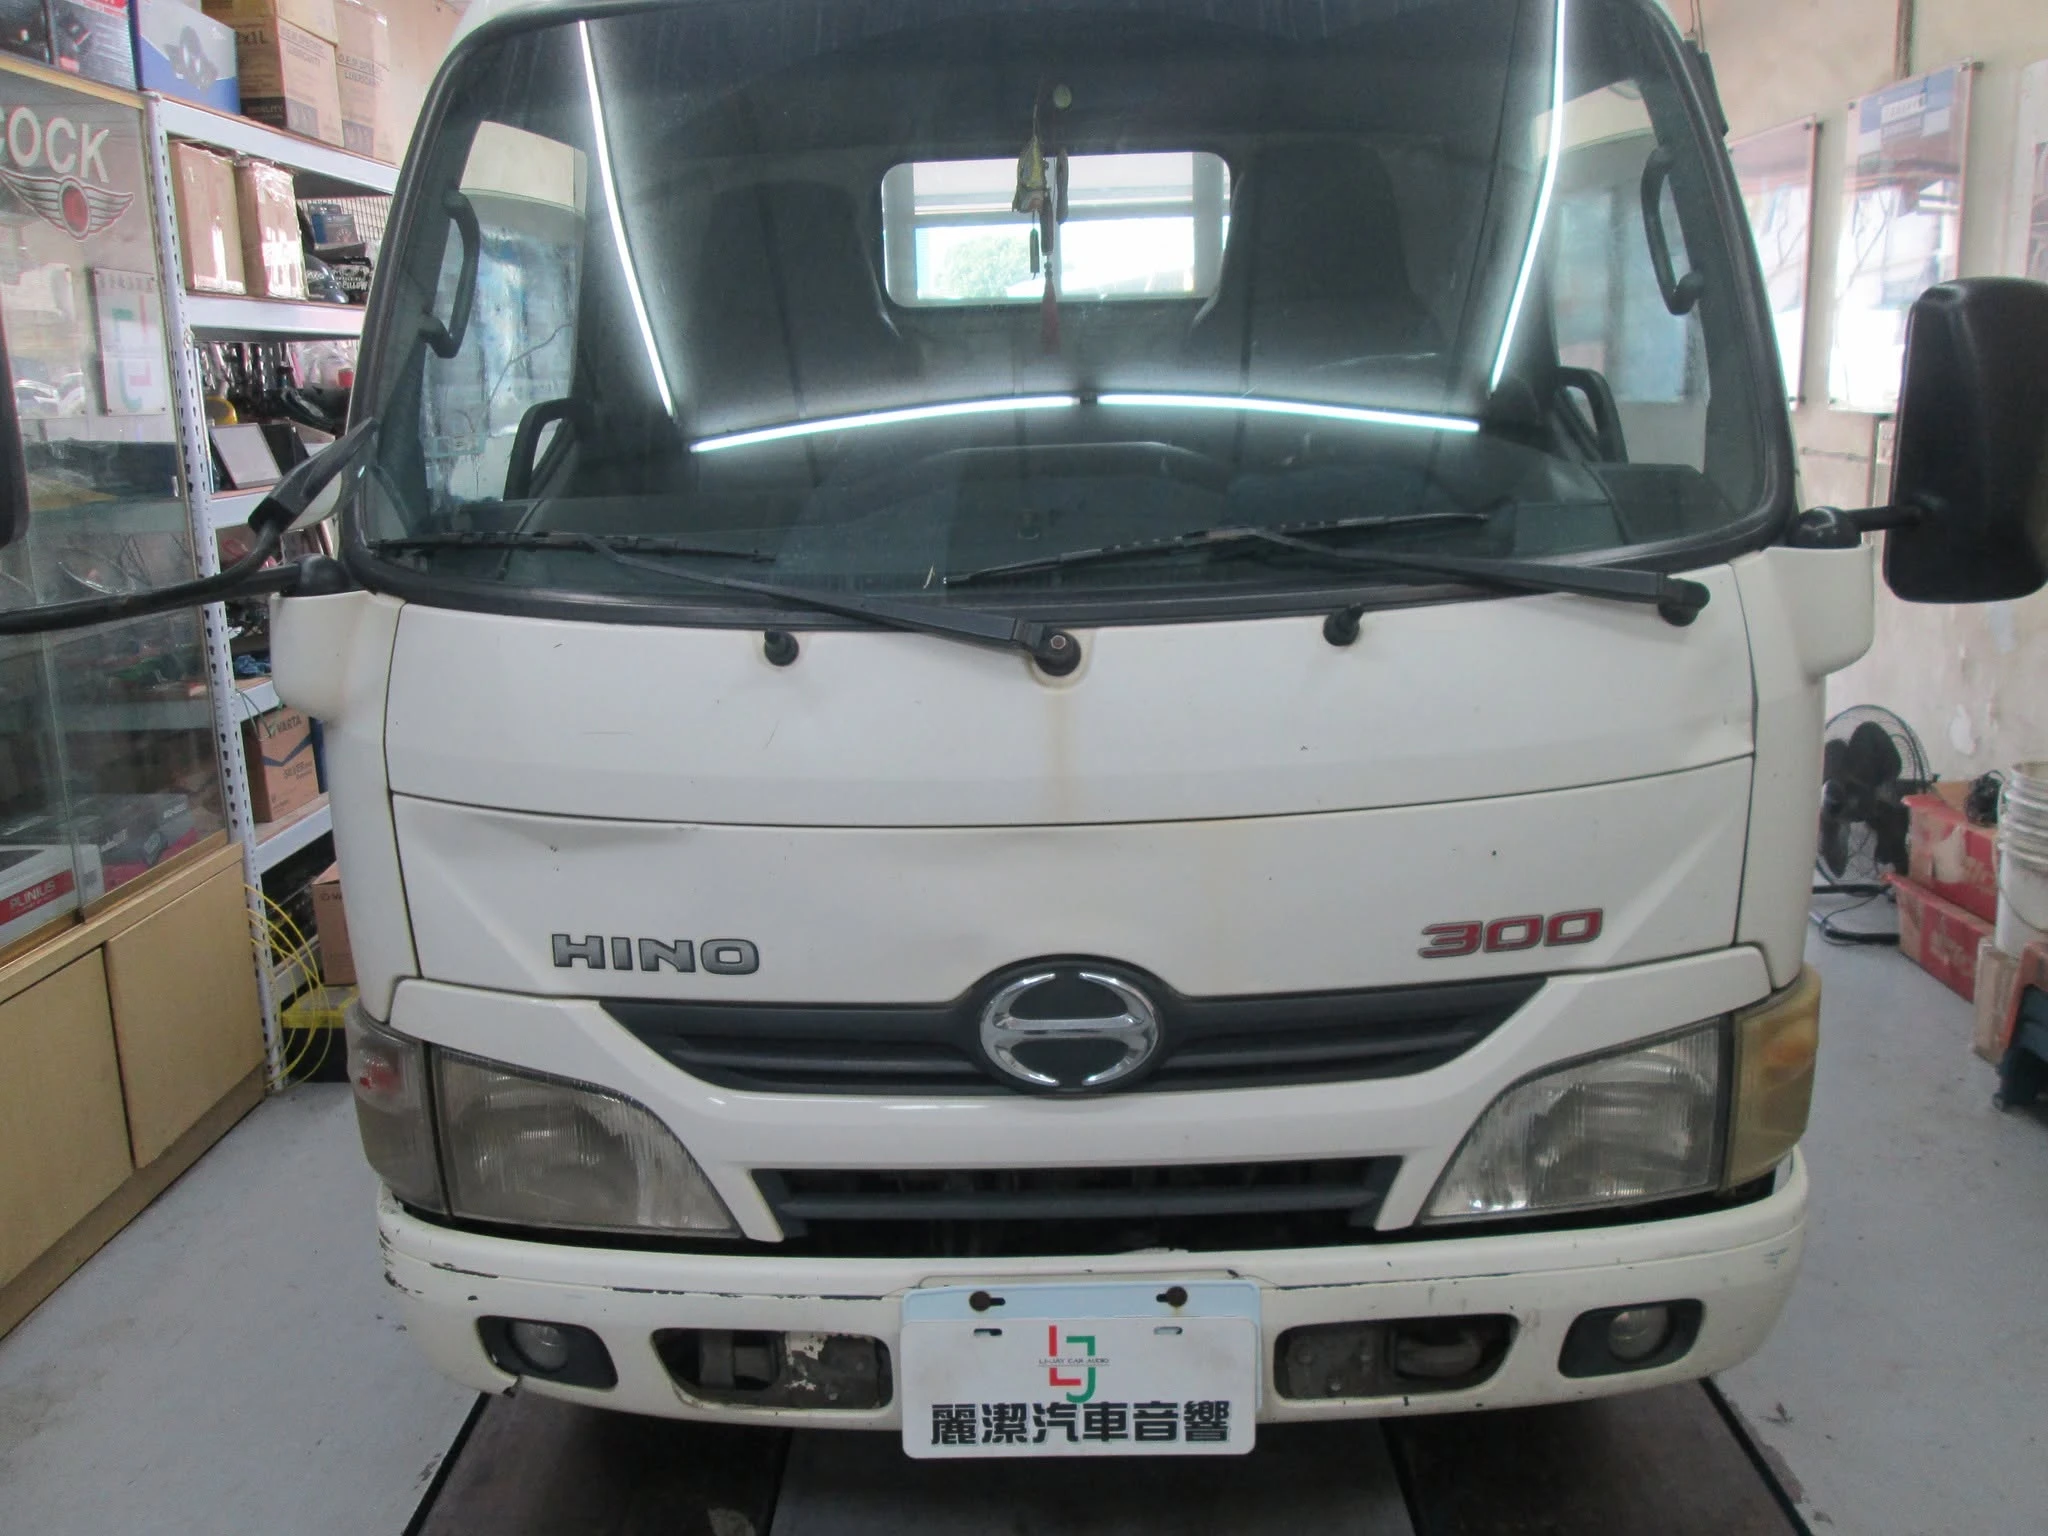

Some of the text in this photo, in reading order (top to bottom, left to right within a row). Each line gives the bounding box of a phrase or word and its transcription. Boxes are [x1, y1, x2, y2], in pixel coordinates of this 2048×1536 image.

[0, 105, 110, 184] OCK
[552, 934, 760, 976] HINO
[1418, 908, 1603, 959] 300
[931, 1400, 1230, 1445] 麗潔汽車音響
